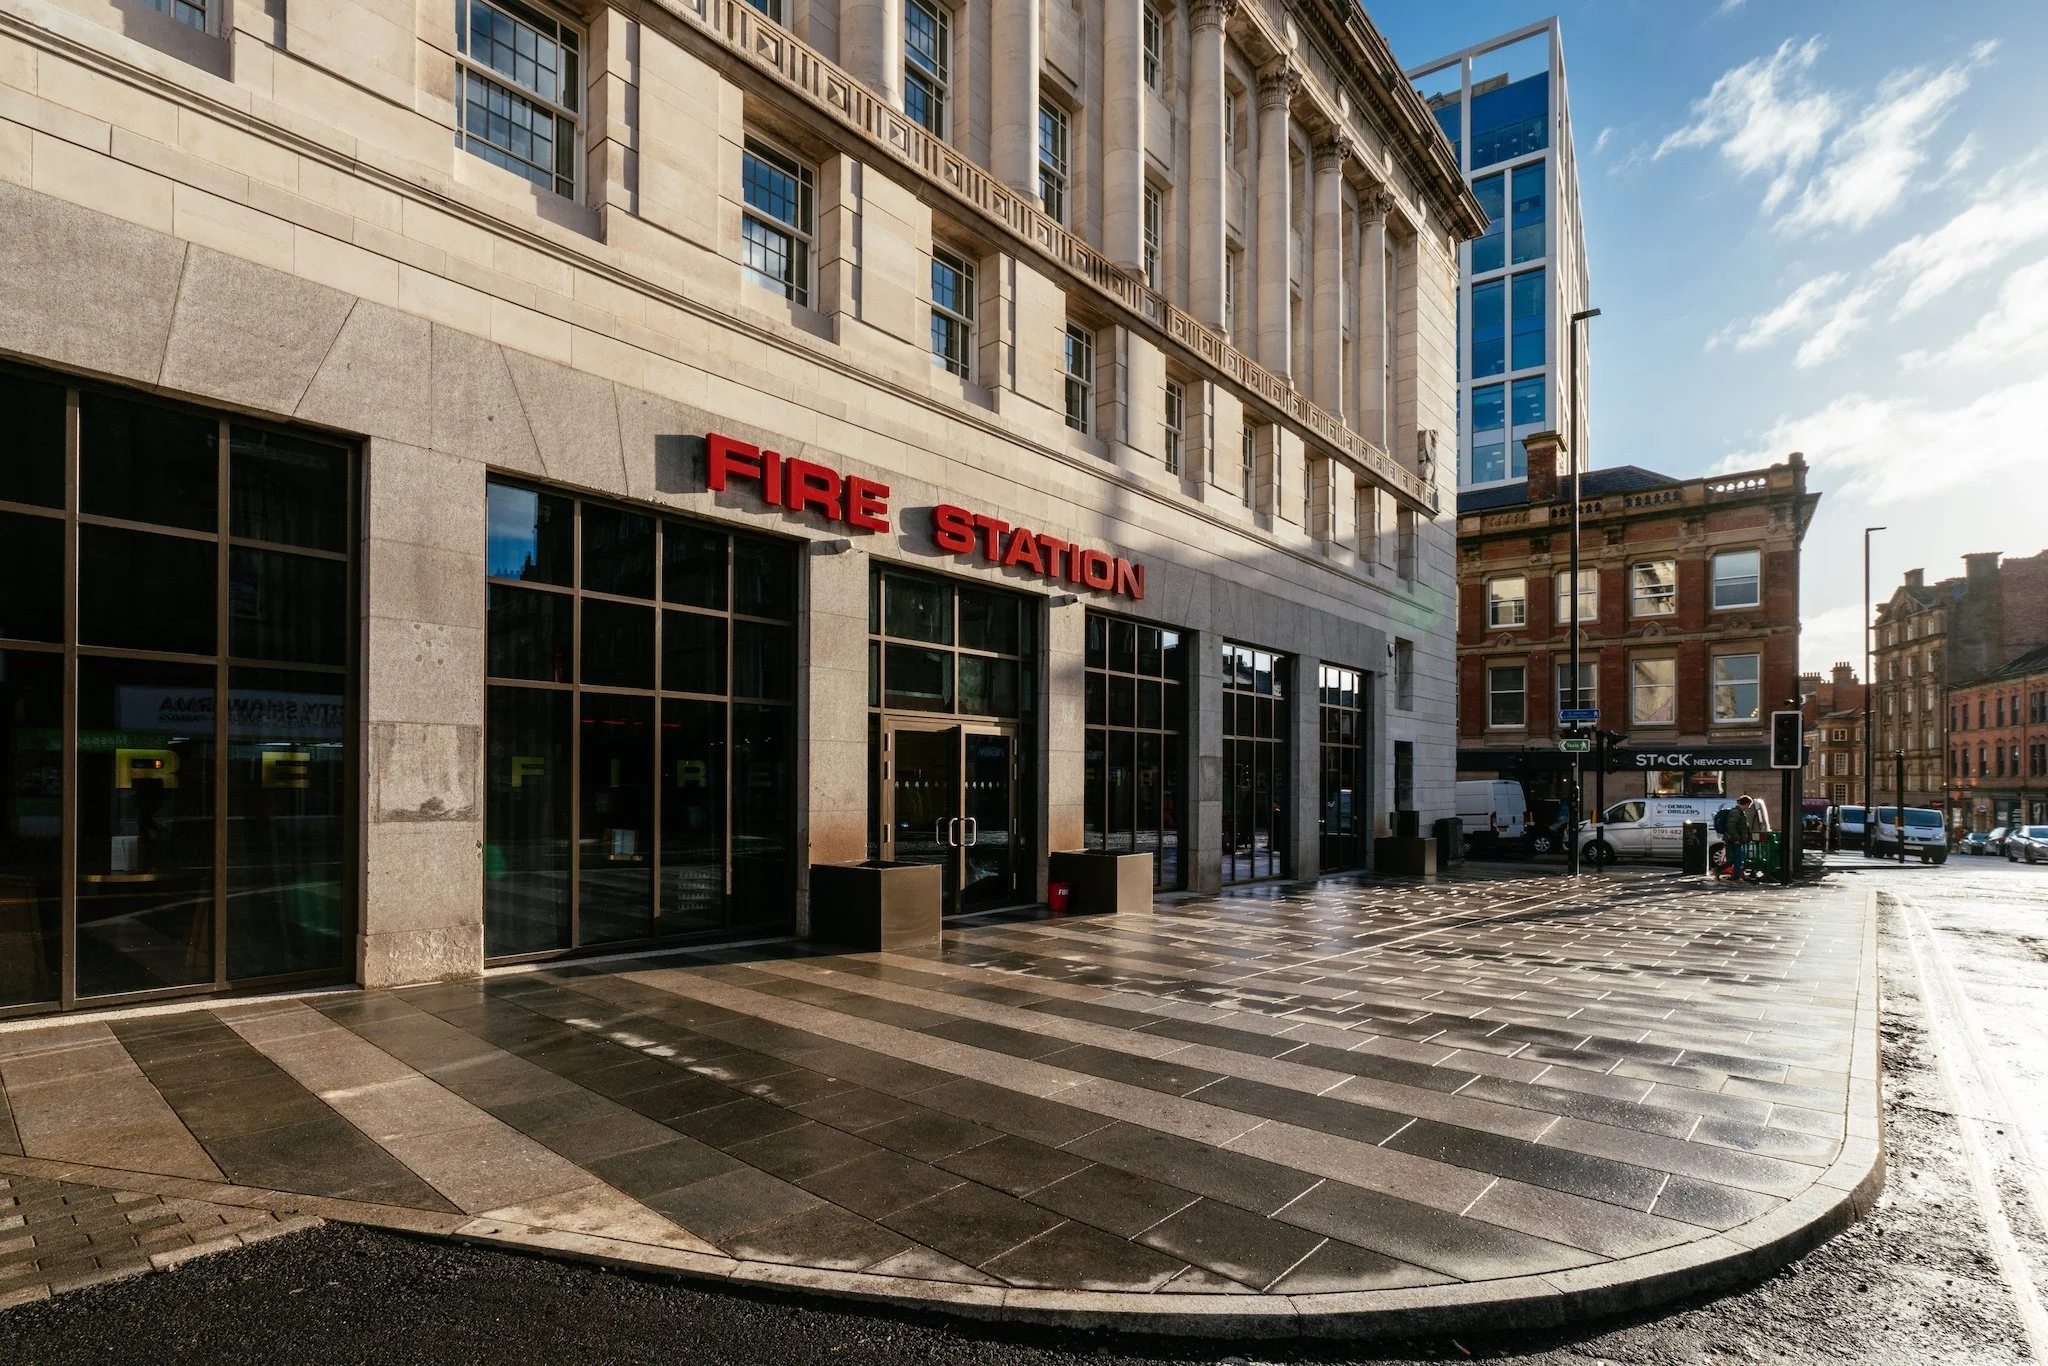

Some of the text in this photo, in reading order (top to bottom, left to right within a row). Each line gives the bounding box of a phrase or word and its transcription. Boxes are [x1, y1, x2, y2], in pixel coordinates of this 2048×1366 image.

[706, 432, 1144, 599] FIRE STATION
[1635, 753, 1753, 766] STACK NEWCASTLE
